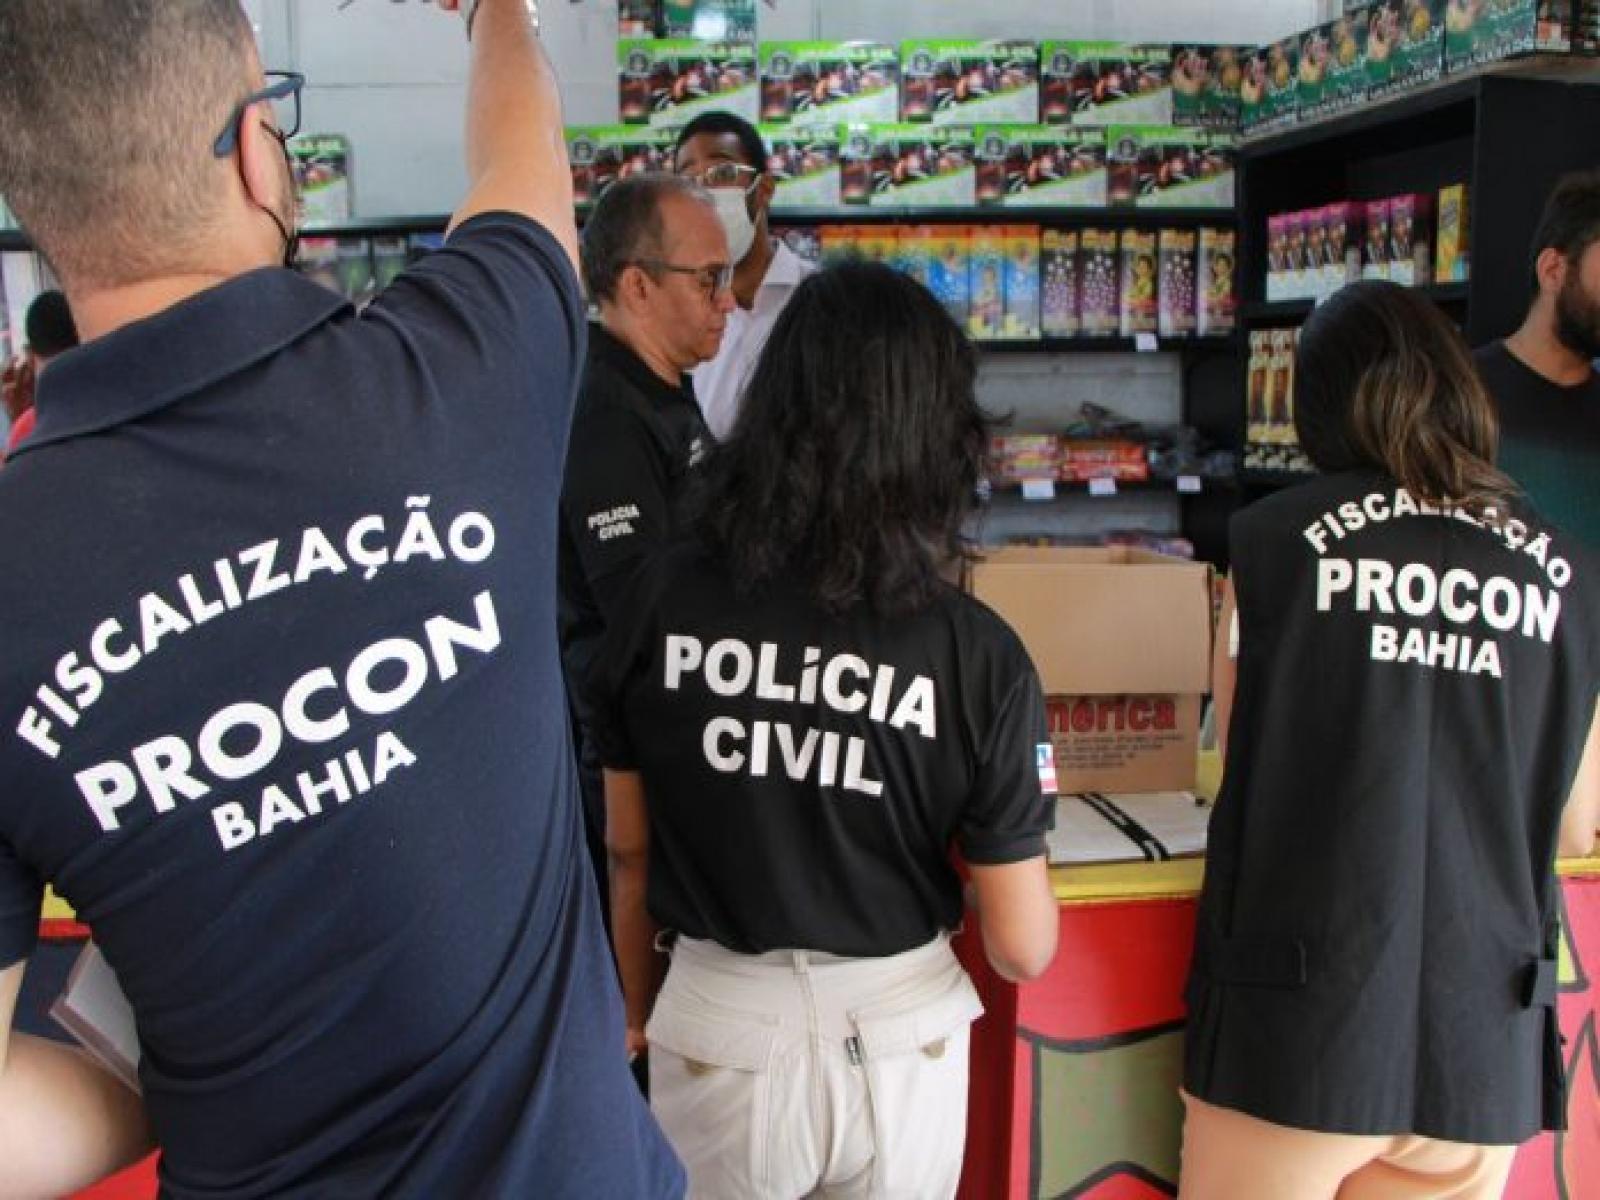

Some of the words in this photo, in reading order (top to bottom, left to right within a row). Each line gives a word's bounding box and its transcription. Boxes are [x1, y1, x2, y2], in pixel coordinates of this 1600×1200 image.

[599, 521, 634, 541] CIVIL
[16, 494, 496, 759] FISCALIZAÇÃO
[1316, 558, 1562, 643] PROCON
[664, 635, 937, 739] POLÍCIA
[1370, 624, 1502, 679] BAHIA
[73, 589, 502, 831] PROCON
[703, 716, 884, 796] CIVIL
[211, 731, 417, 851] BAHIA
